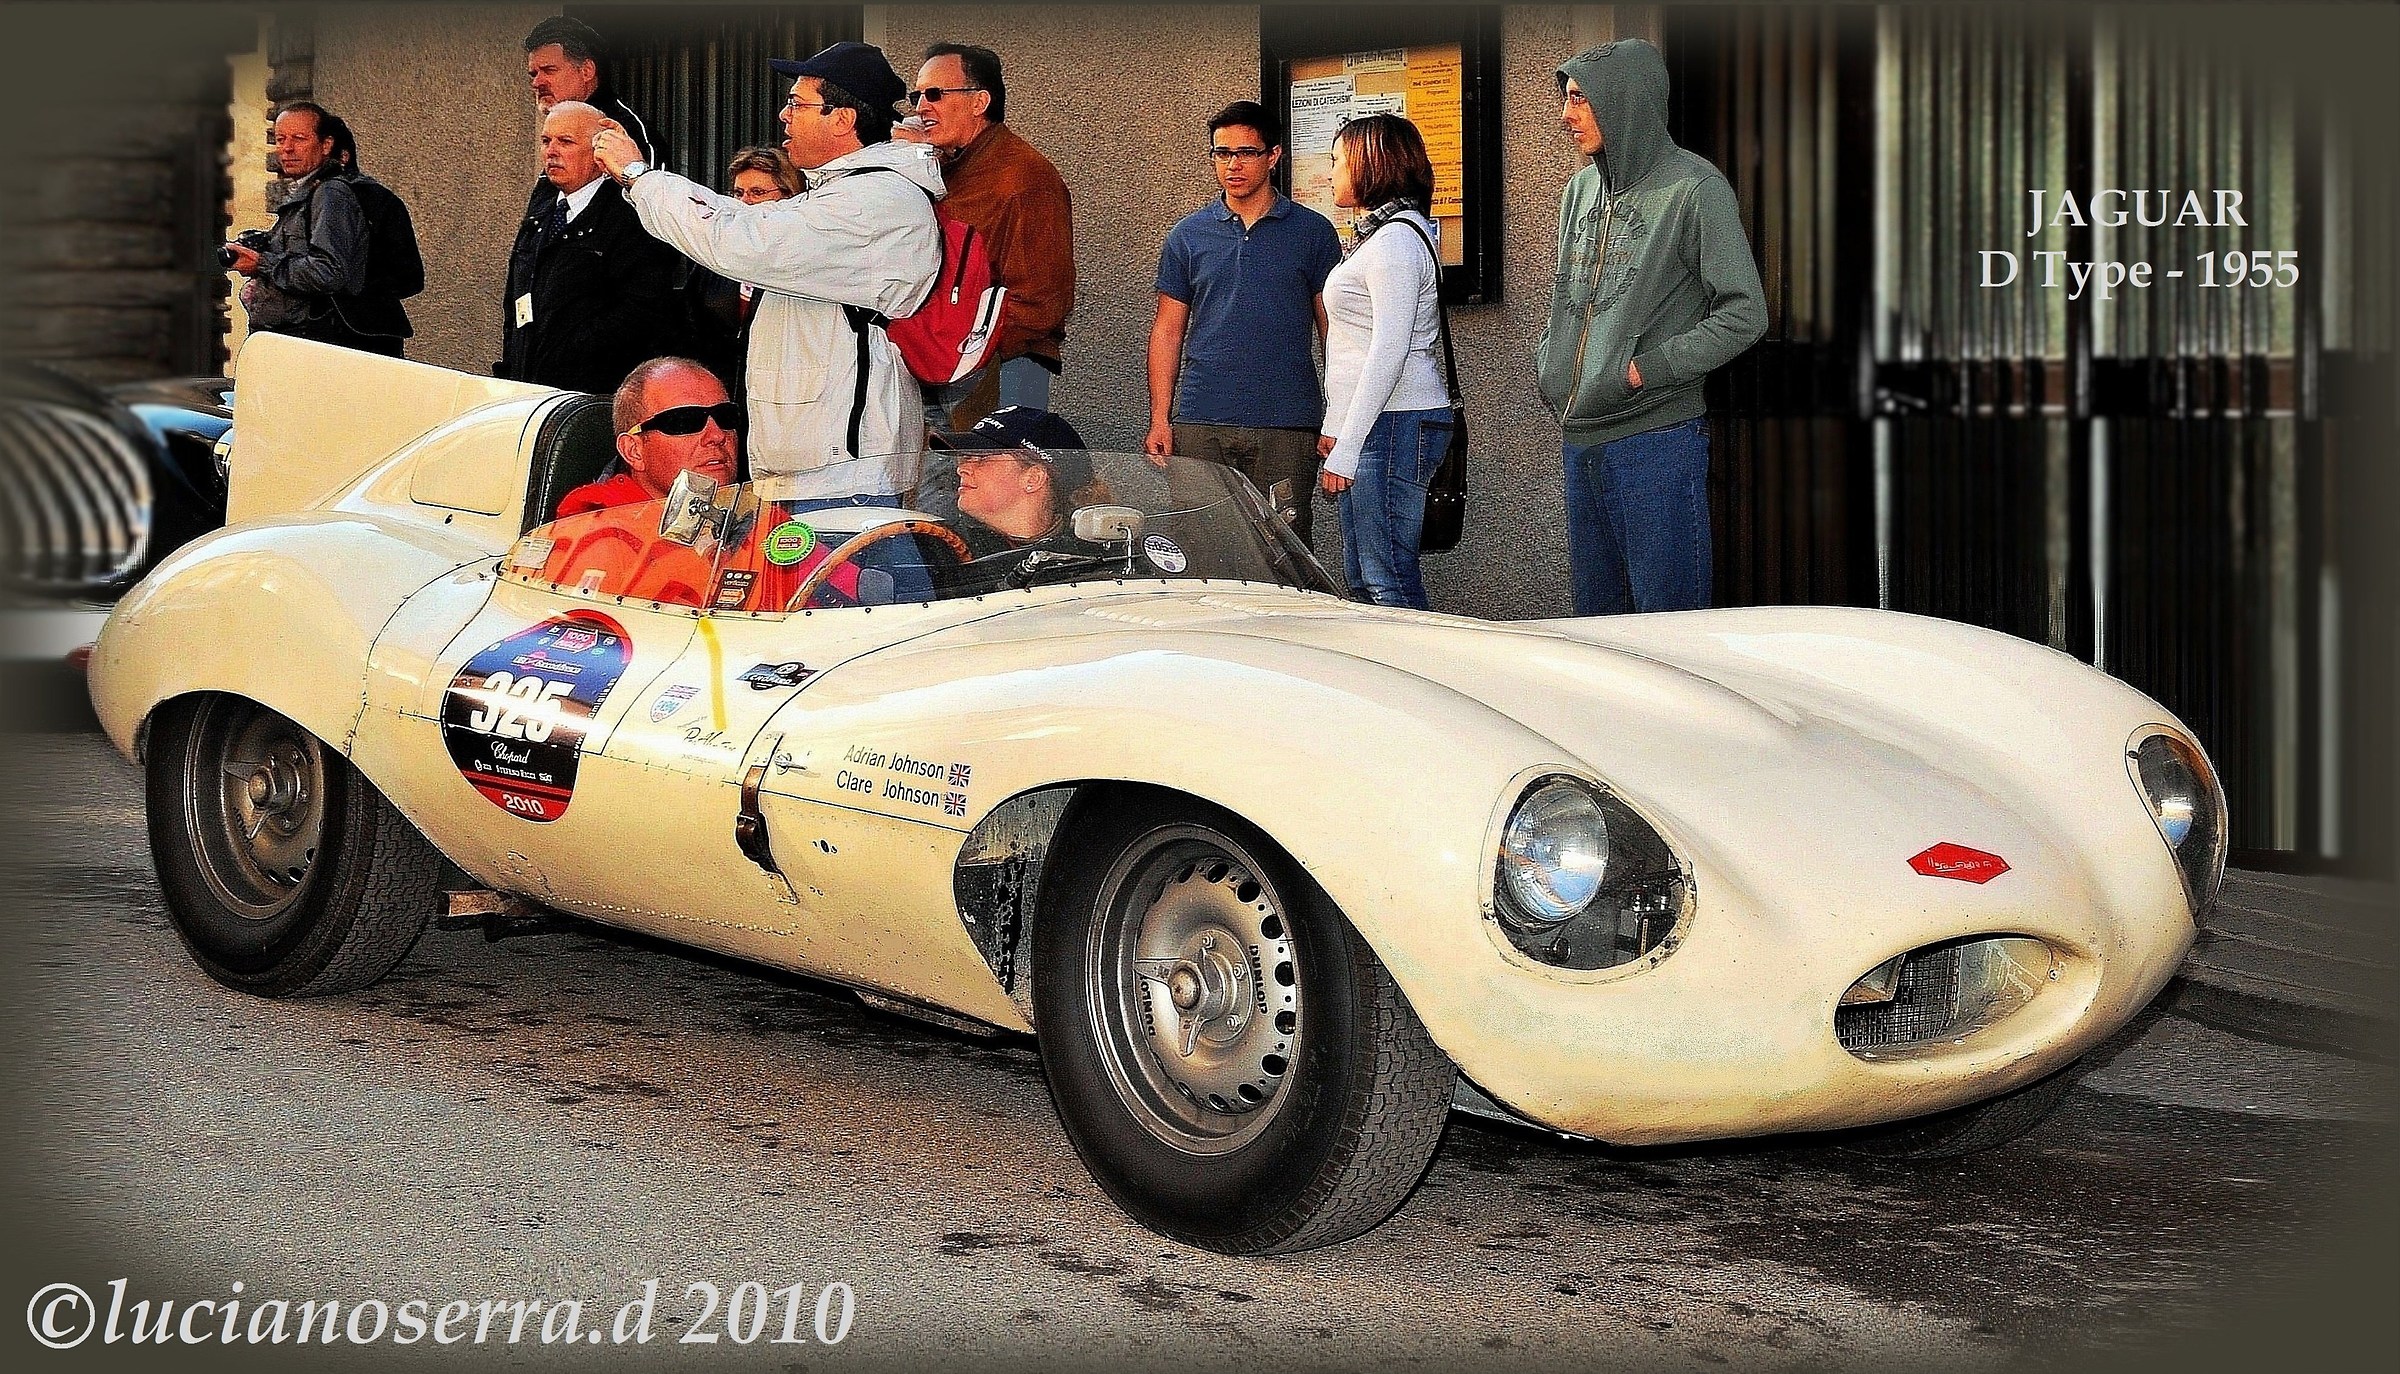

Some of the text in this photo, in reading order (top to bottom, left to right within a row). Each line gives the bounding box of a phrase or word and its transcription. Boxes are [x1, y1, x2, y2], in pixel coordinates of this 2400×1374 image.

[470, 671, 576, 743] 325
[490, 741, 531, 764] Chopard
[844, 744, 944, 780] Adrian Johnson
[502, 793, 545, 815] 2010
[836, 770, 939, 807] Clare Johnson
[1249, 944, 1268, 1014] DUNLOP
